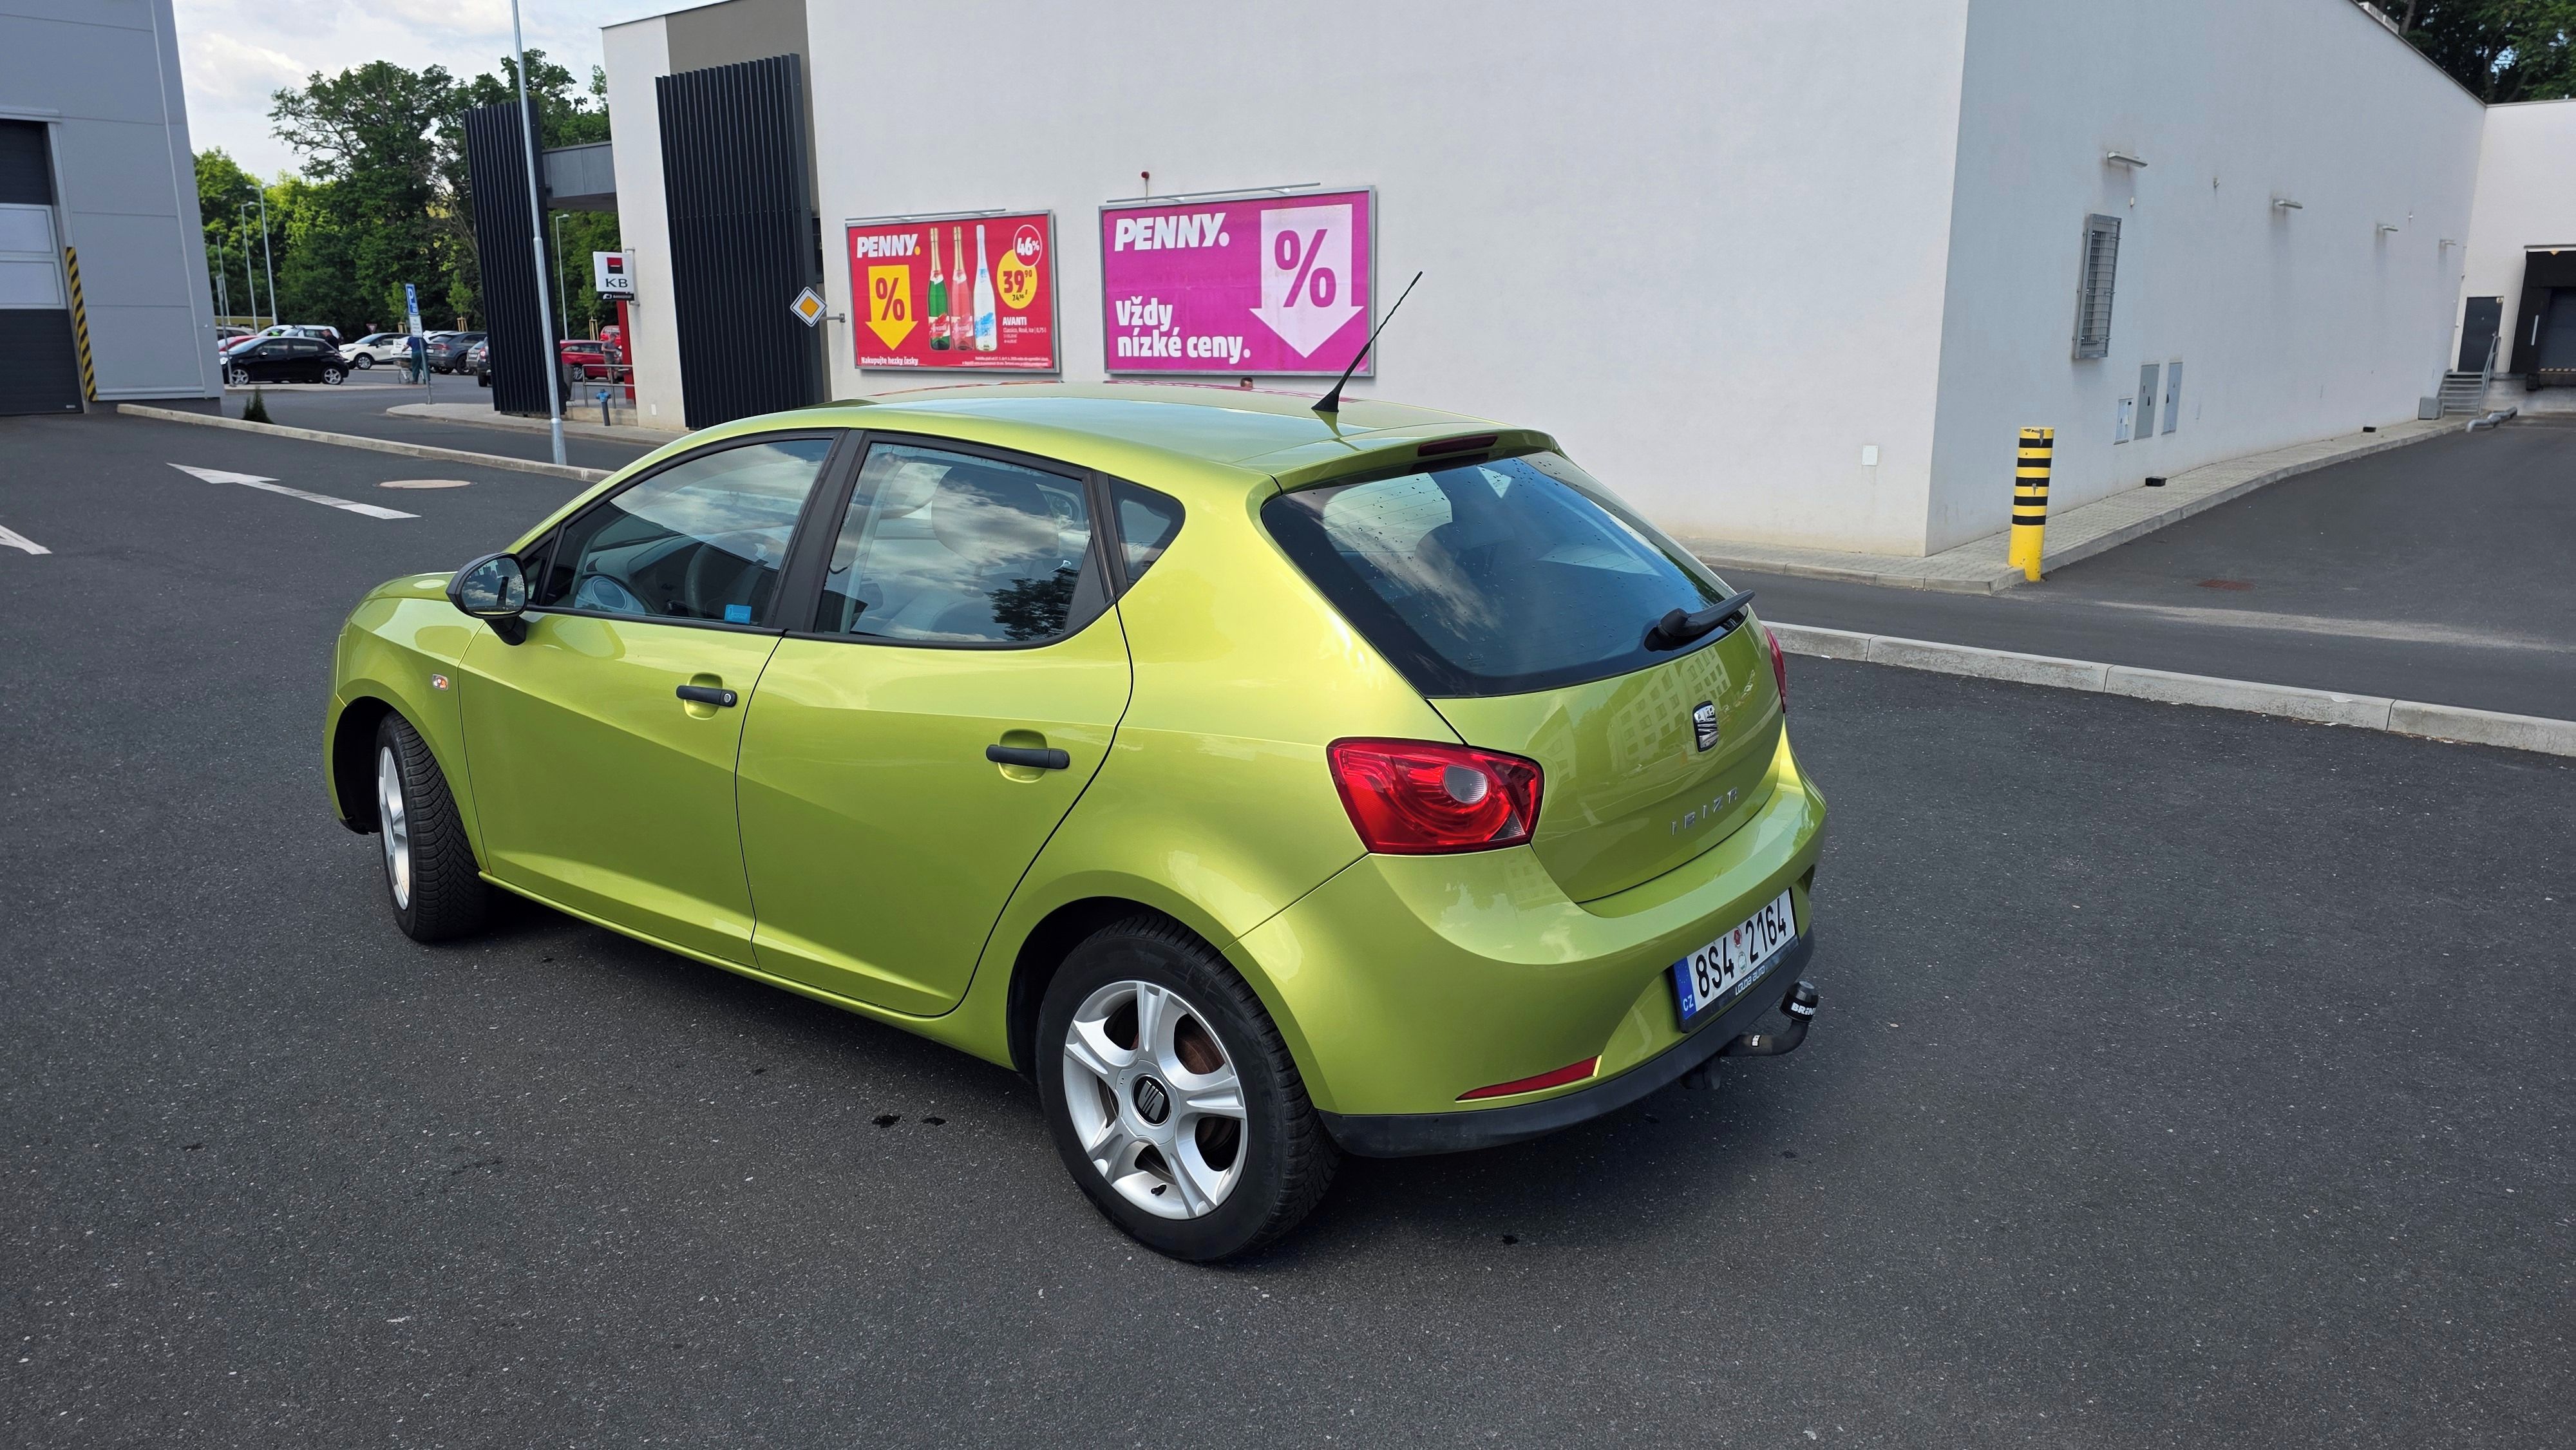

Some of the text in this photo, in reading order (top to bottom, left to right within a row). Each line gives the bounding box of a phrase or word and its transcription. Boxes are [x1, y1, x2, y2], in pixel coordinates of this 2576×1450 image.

[1115, 212, 1229, 252] PENNY.
[605, 278, 629, 288] KB
[407, 288, 414, 306] P
[1002, 316, 1027, 325] AVANTI
[1115, 296, 1173, 331] Vždy
[1117, 327, 1251, 364] nízké ceny.
[860, 356, 919, 366] Nakupujte hezky česky
[1671, 787, 1738, 836] IBIZA
[1695, 898, 1786, 998] 8S4 2164
[1682, 993, 1695, 1012] CZ
